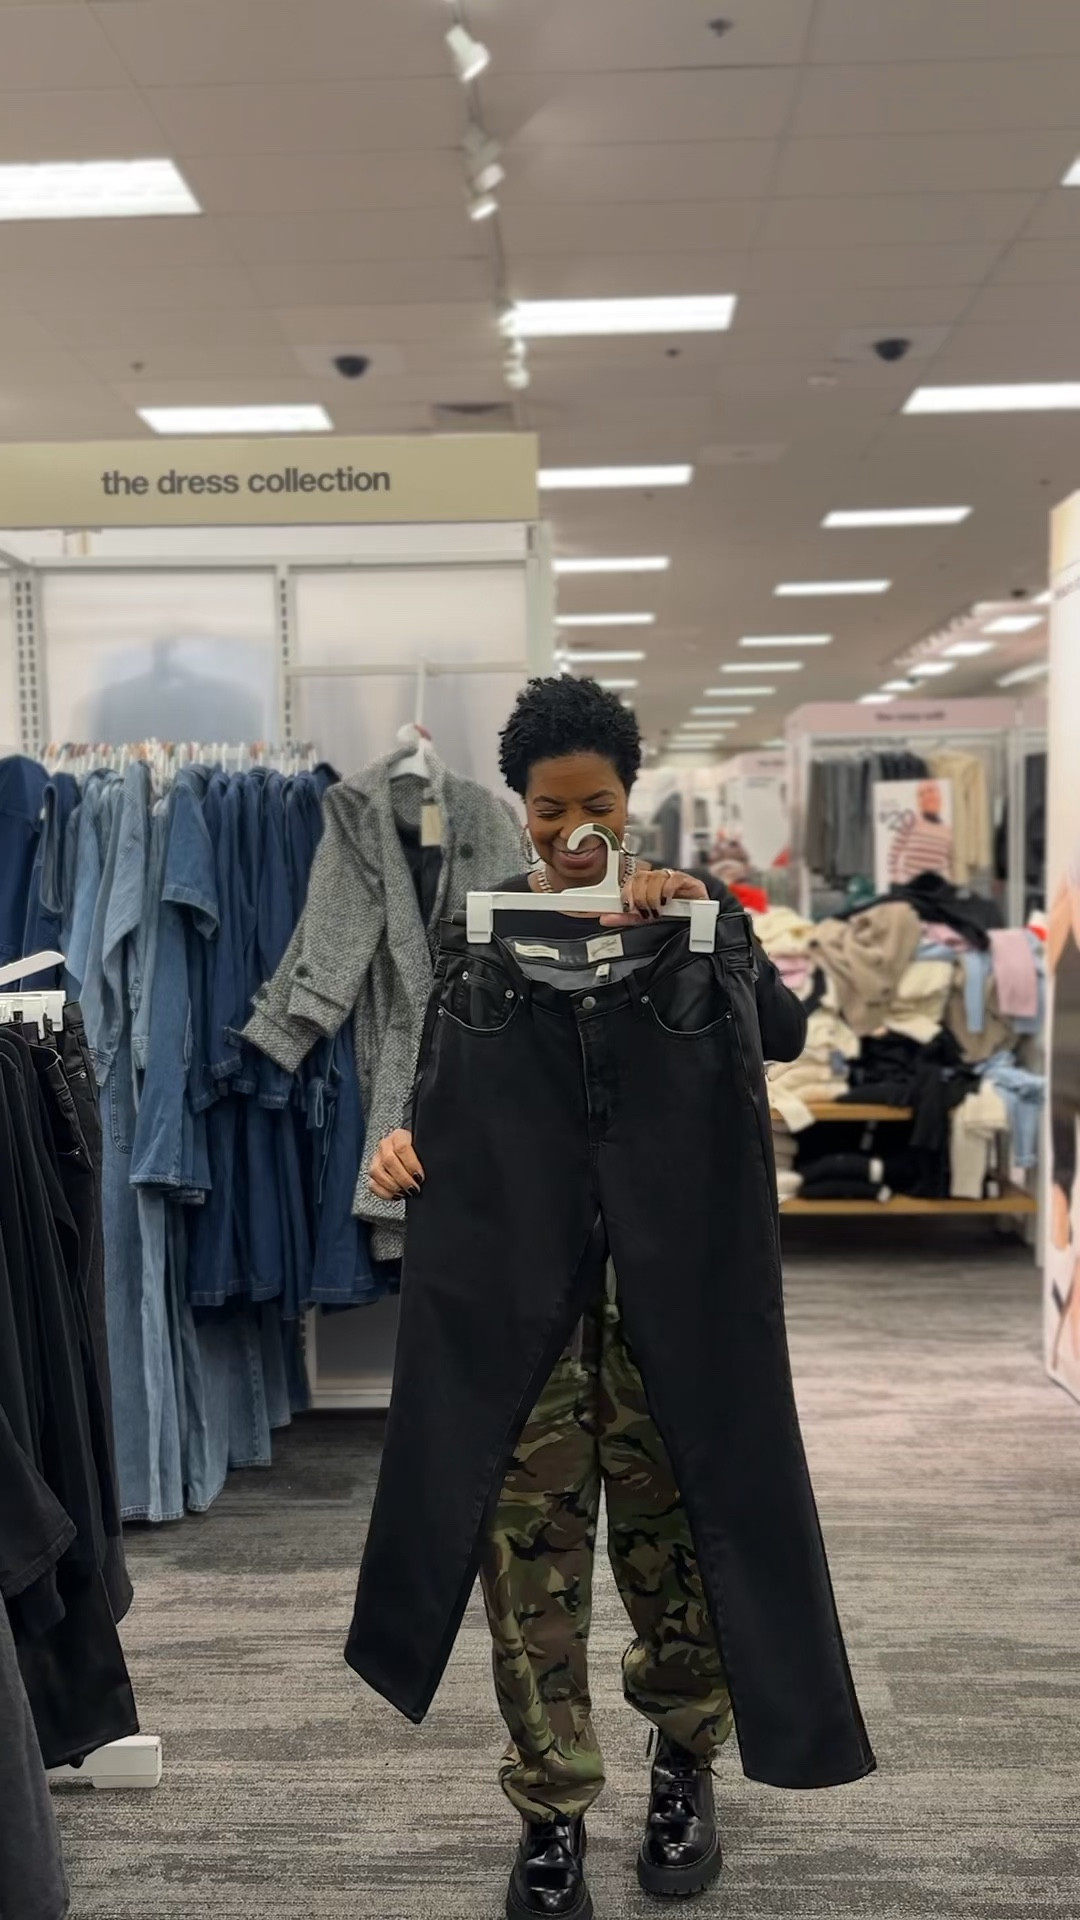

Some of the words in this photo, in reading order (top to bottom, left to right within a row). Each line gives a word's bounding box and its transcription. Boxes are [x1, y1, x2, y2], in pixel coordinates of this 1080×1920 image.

[101, 470, 148, 496] the
[157, 469, 240, 495] dress
[247, 466, 391, 493] collection
